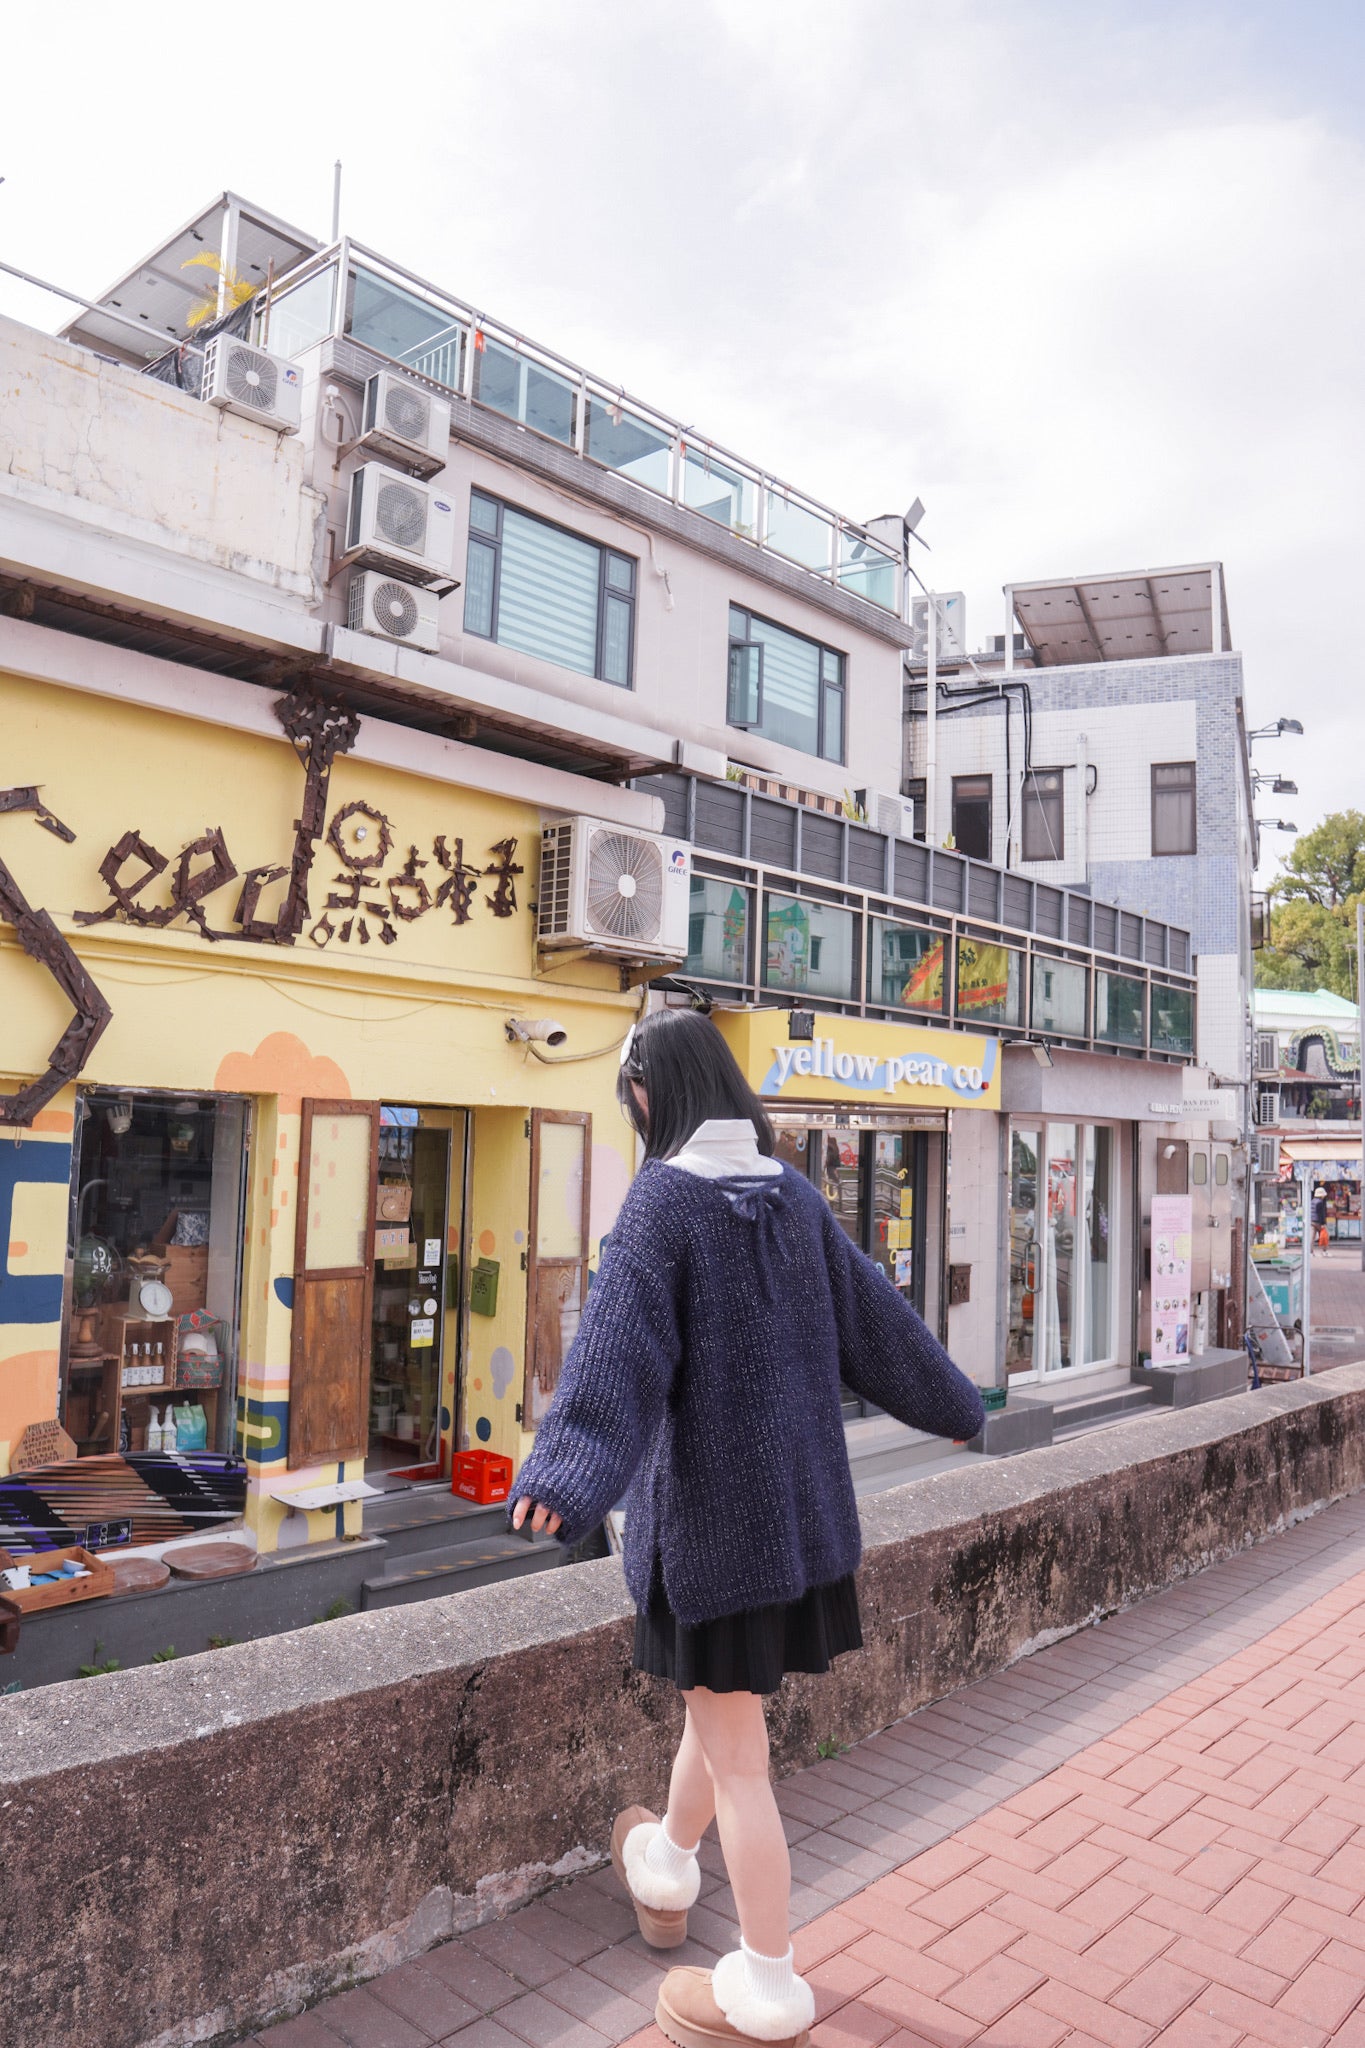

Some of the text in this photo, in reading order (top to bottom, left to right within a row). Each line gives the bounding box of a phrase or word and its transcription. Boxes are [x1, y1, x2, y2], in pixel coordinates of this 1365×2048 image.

[667, 865, 688, 876] GREE
[773, 1037, 989, 1094] yellow pear co.
